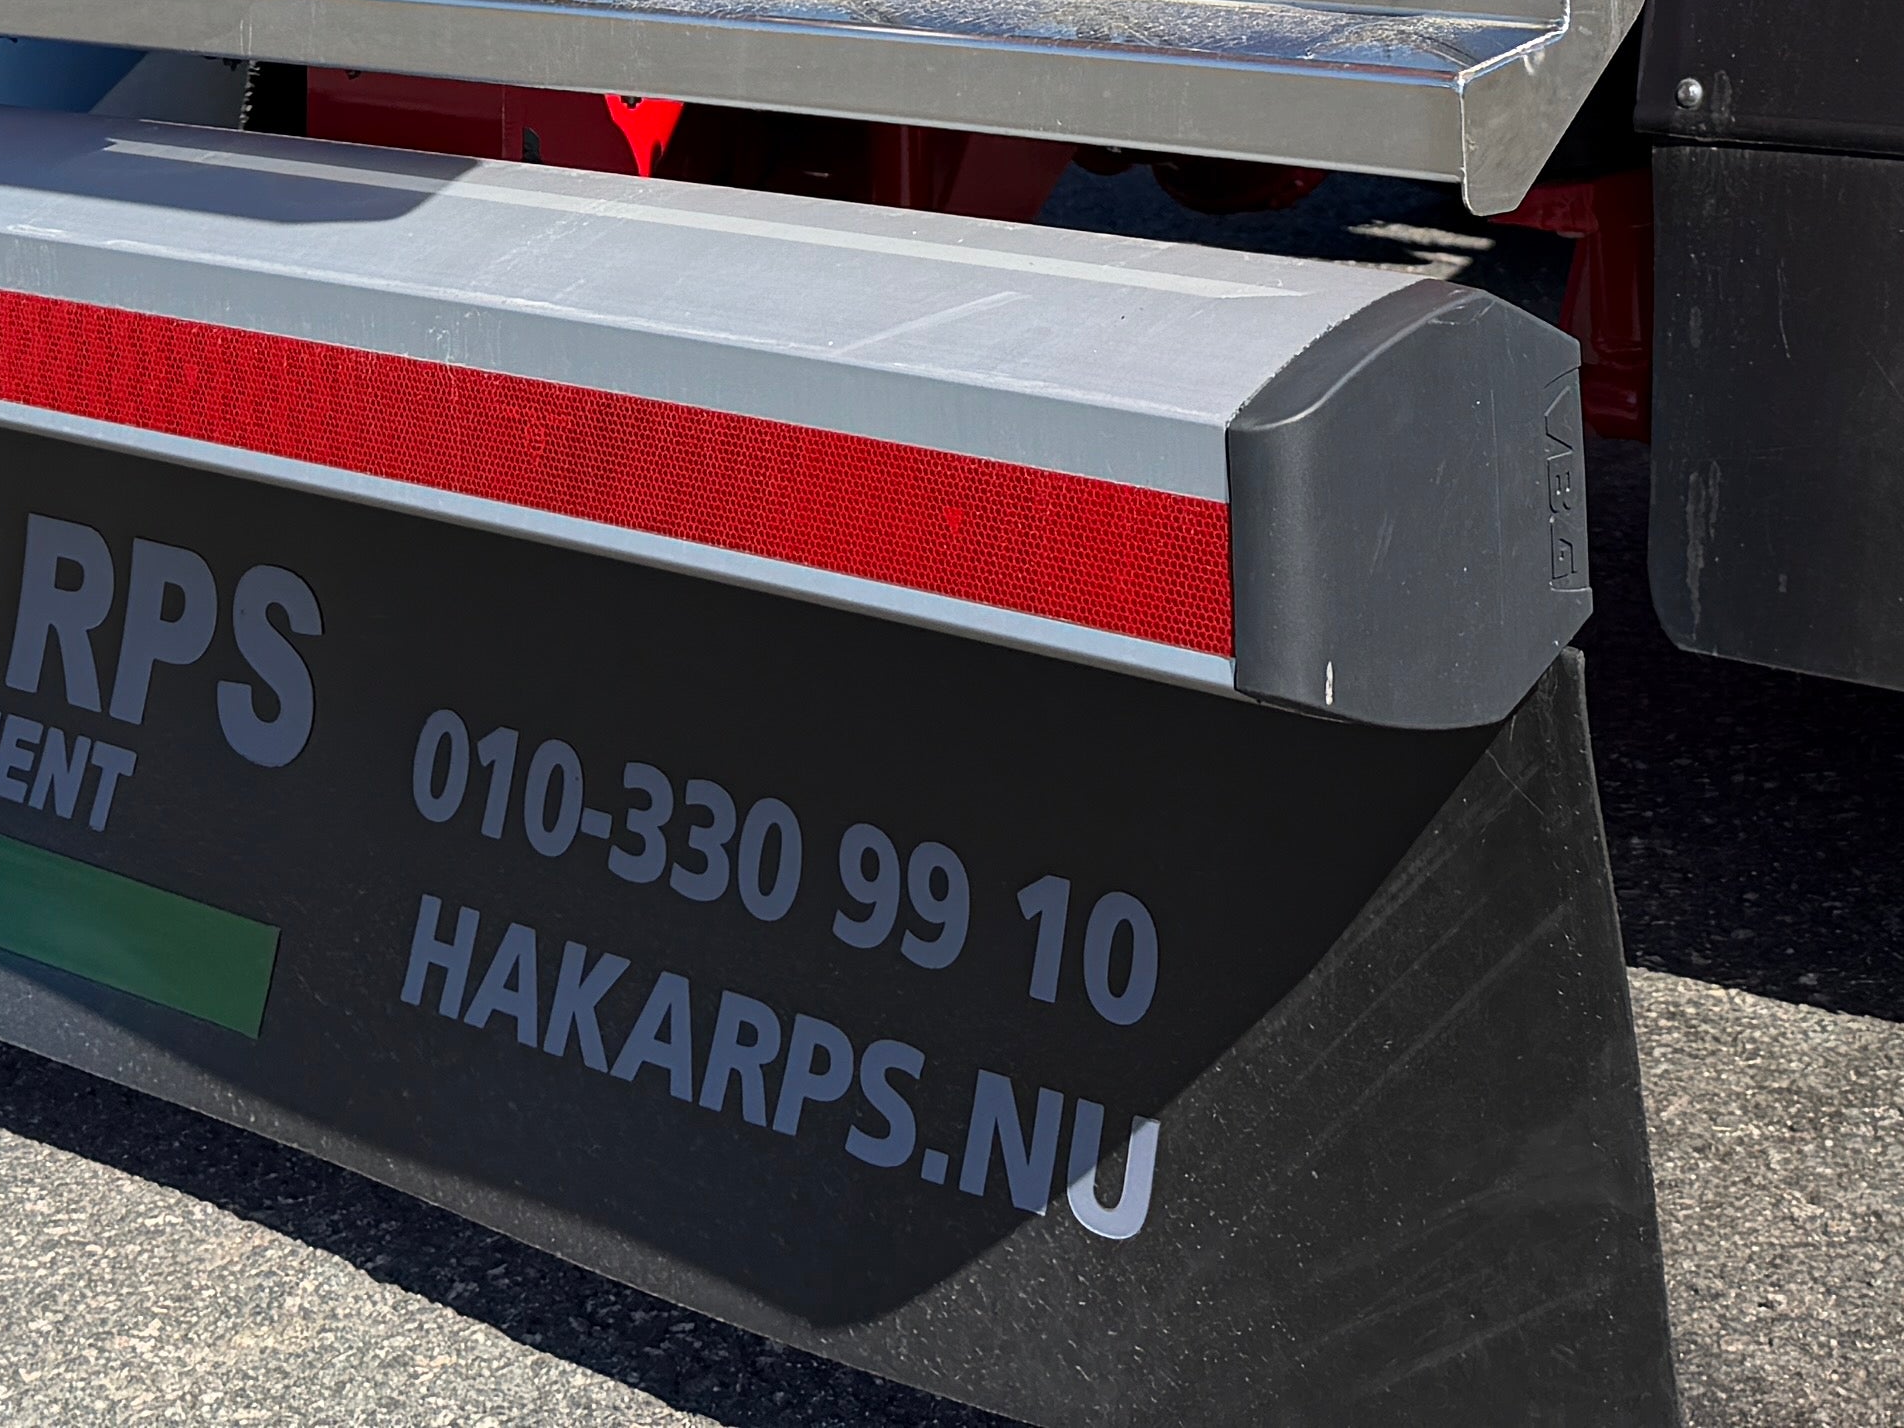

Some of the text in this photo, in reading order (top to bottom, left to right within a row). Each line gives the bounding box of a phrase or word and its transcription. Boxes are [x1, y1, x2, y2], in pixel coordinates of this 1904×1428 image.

[412, 709, 1159, 1026] 010-330 99 10
[400, 893, 1161, 1240] HAKARPS.NU
